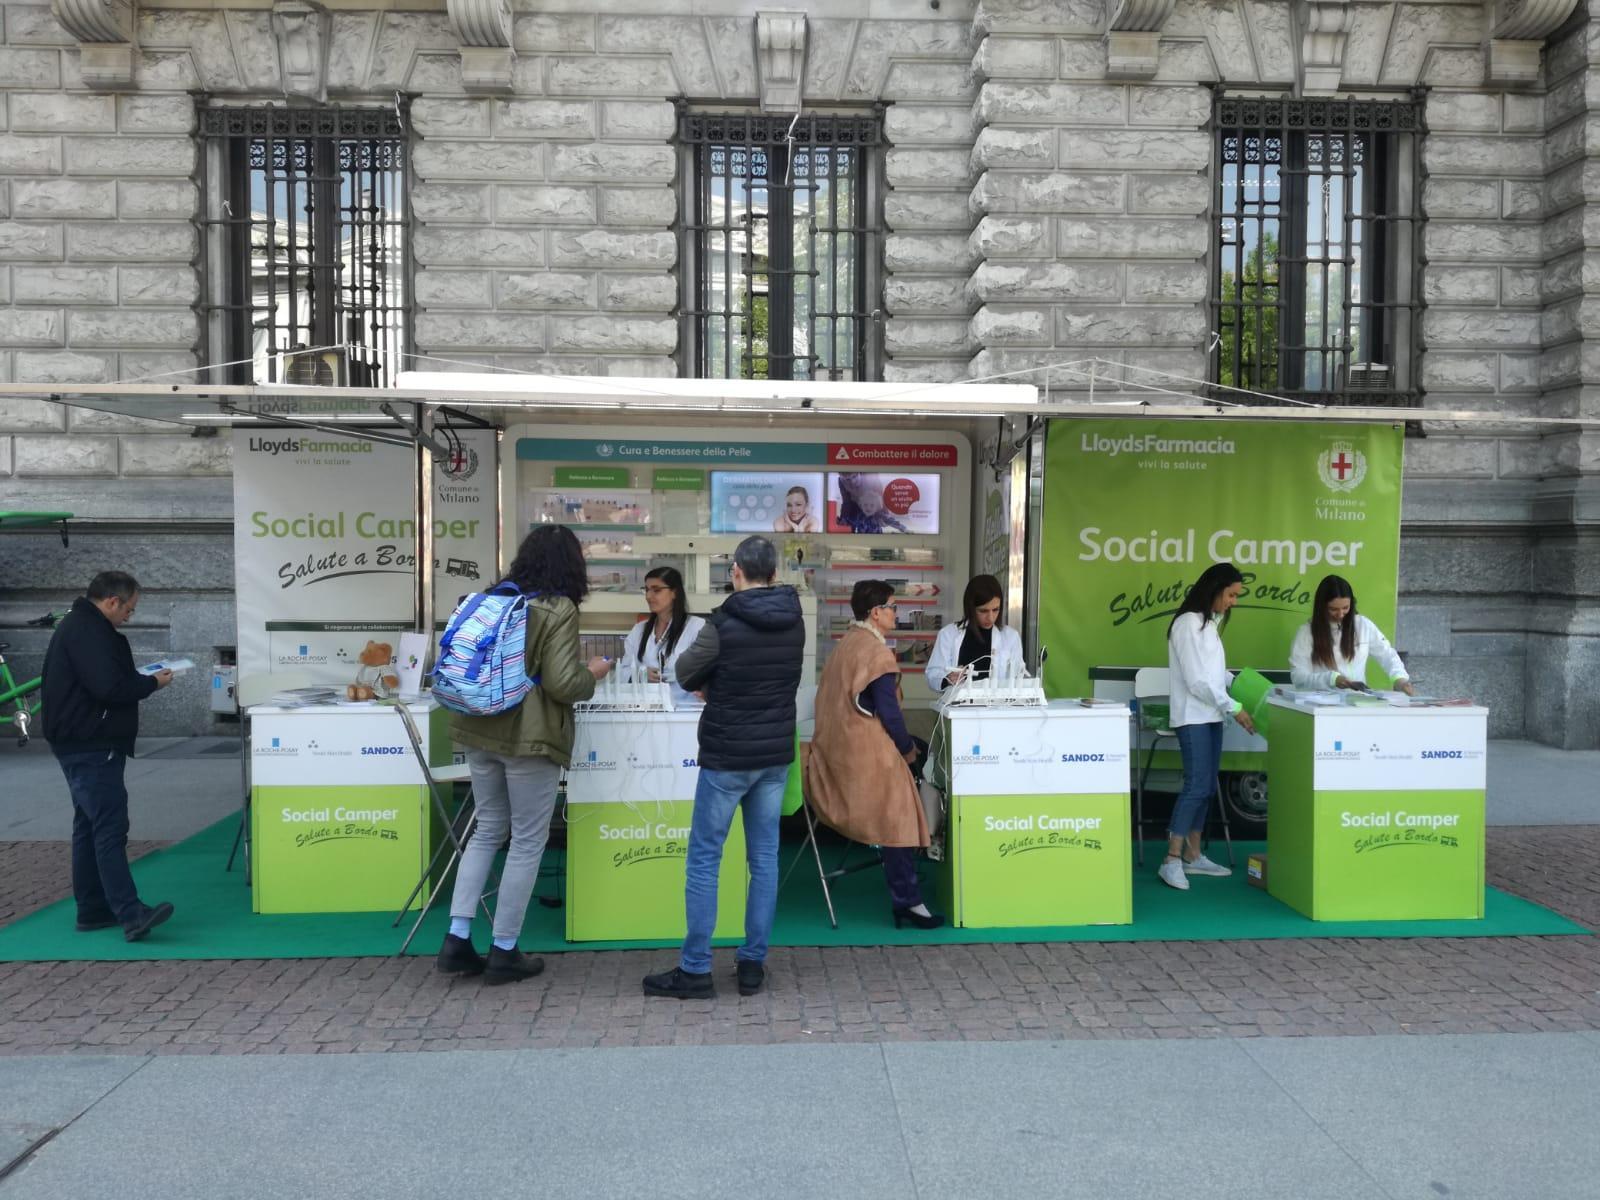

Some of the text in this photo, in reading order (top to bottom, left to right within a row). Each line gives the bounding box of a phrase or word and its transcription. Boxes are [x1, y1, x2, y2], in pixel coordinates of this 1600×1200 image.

[249, 437, 372, 456] LloydsFarmacia
[619, 446, 752, 457] Cura e Benessere della Pelle
[852, 449, 950, 459] Combattere il dolore
[1081, 434, 1235, 456] LloydsFarmacia
[1138, 459, 1207, 470] vivi la salute
[439, 493, 480, 504] Milano
[1315, 497, 1358, 506] Comune
[1316, 507, 1366, 521] Milano
[251, 511, 344, 539] Social
[1079, 527, 1364, 574] Social Camper
[278, 552, 348, 589] Salute
[354, 551, 368, 566] a
[361, 746, 404, 755] SANDOZ
[1061, 753, 1105, 762] SANDOZ
[1421, 750, 1462, 759] SANDOZ
[281, 806, 399, 824] Social Camper
[984, 814, 1102, 833] Social Camper
[1341, 811, 1460, 830] Social Camper
[295, 823, 378, 848] Salute a Bordo
[599, 823, 650, 840] Social
[998, 832, 1082, 858] Salute a Bordo
[1354, 833, 1390, 854] Salute
[1404, 828, 1438, 843] Bordo
[613, 845, 651, 868] Salute
